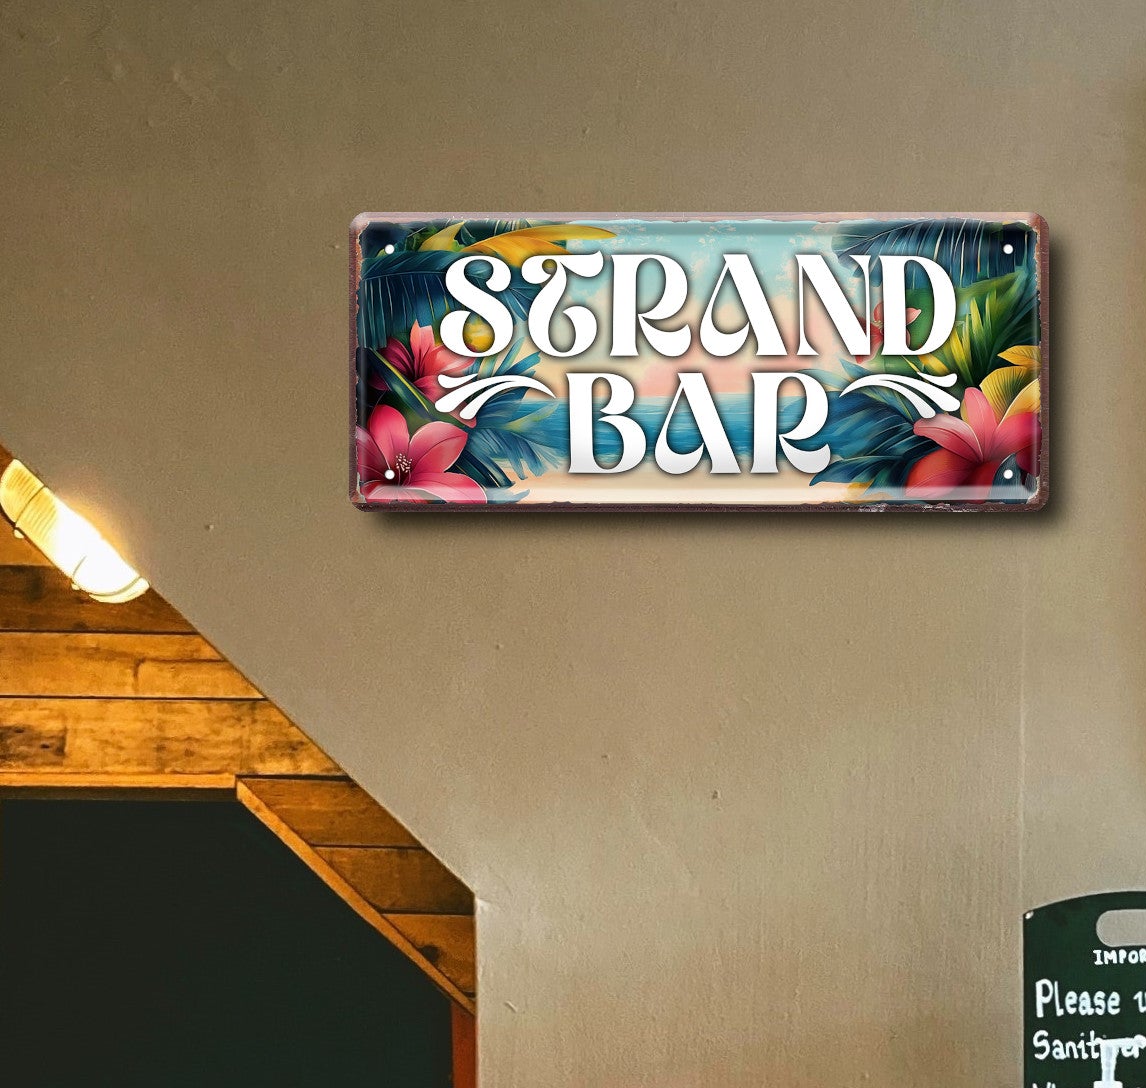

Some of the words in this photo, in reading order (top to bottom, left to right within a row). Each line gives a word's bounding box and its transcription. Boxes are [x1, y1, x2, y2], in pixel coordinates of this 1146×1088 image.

[438, 249, 957, 358] STRAND
[568, 372, 831, 476] BAR
[1035, 978, 1121, 1018] Please
[1033, 1029, 1146, 1060] Saniter
